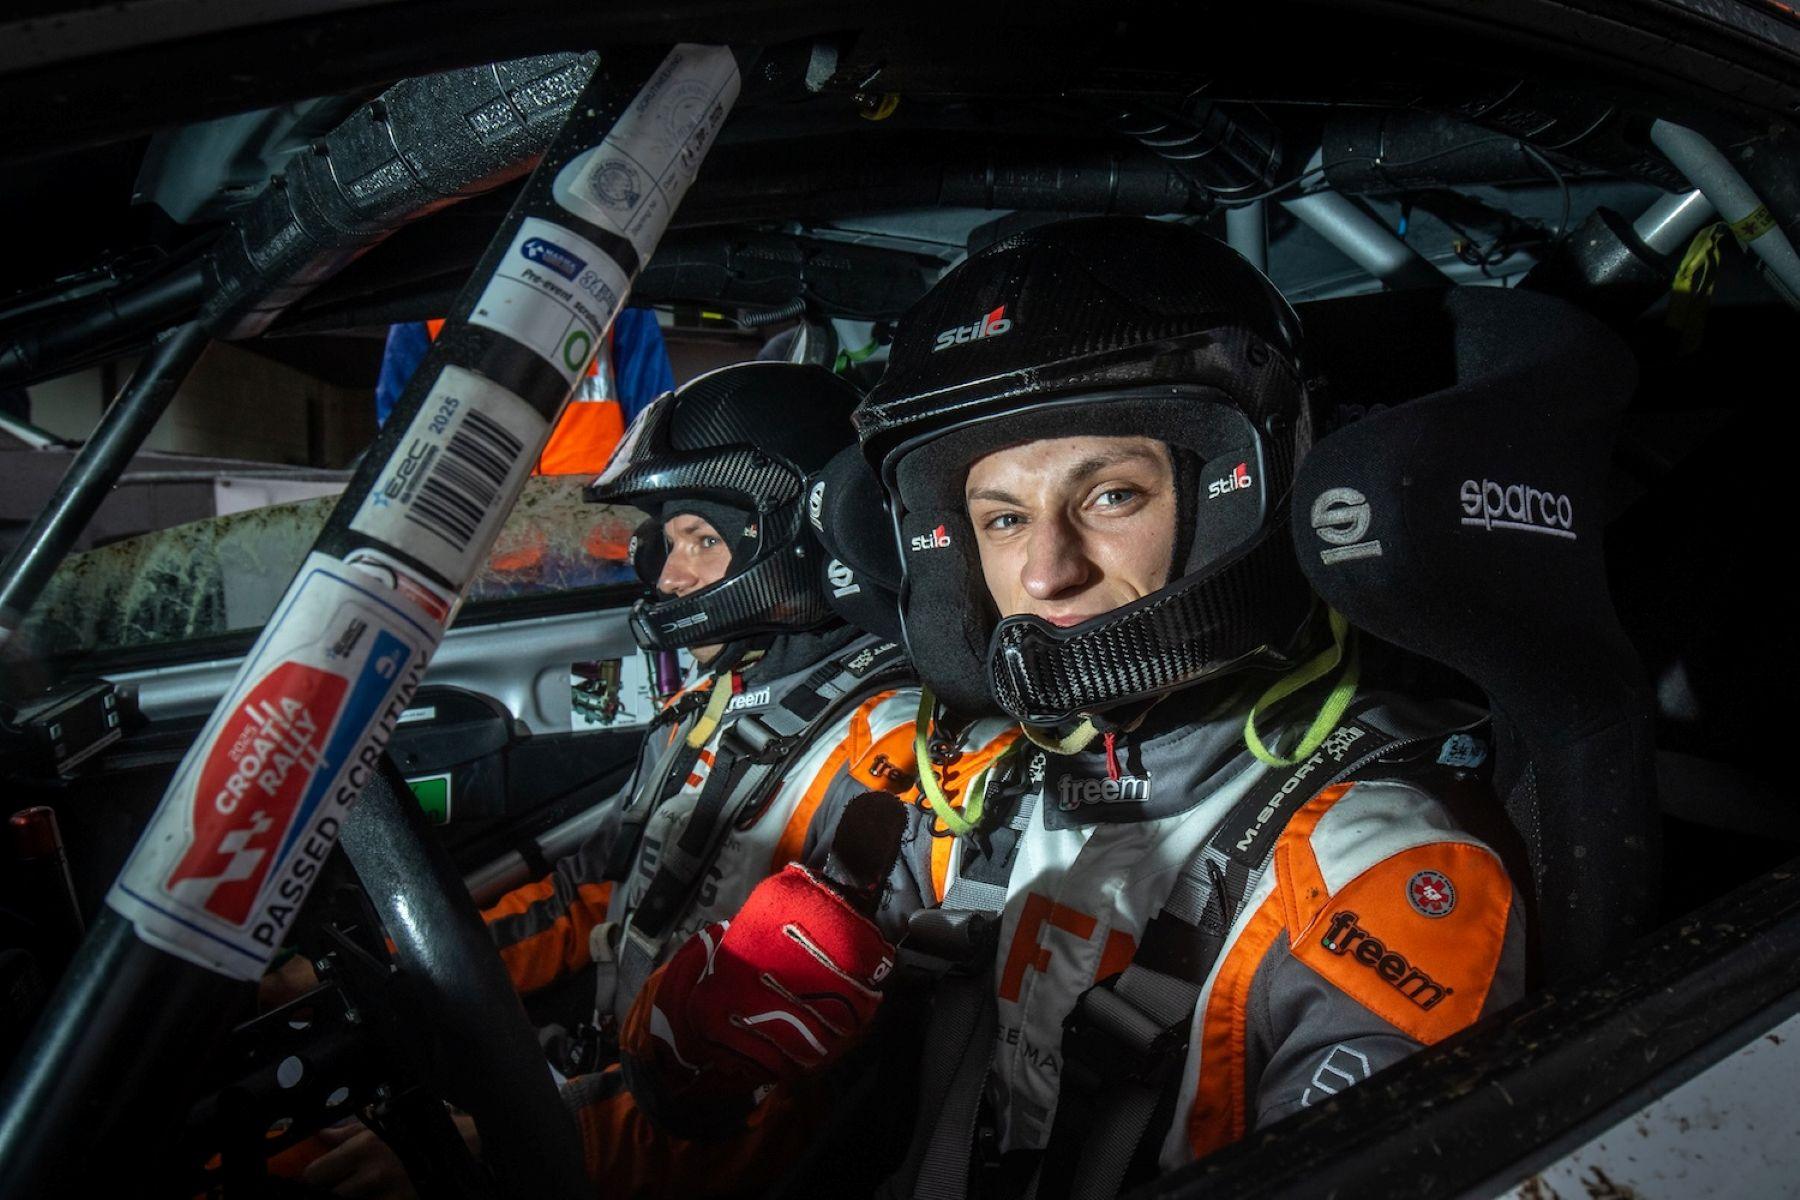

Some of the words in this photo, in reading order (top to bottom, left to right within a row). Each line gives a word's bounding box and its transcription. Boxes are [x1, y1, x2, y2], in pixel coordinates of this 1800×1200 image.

[521, 267, 573, 302] Pre-event
[932, 304, 1013, 353] stilo
[383, 436, 430, 501] ERC
[428, 393, 461, 436] 2025
[1208, 462, 1252, 500] stilo
[911, 523, 950, 553] stilo
[1460, 478, 1573, 531] sparco
[215, 697, 304, 815] CROATIA
[258, 708, 318, 797] RALLY
[1058, 770, 1152, 811] freem
[1235, 750, 1326, 852] M-SPORT
[252, 816, 341, 948] PASSED
[1321, 911, 1447, 1011] freem
